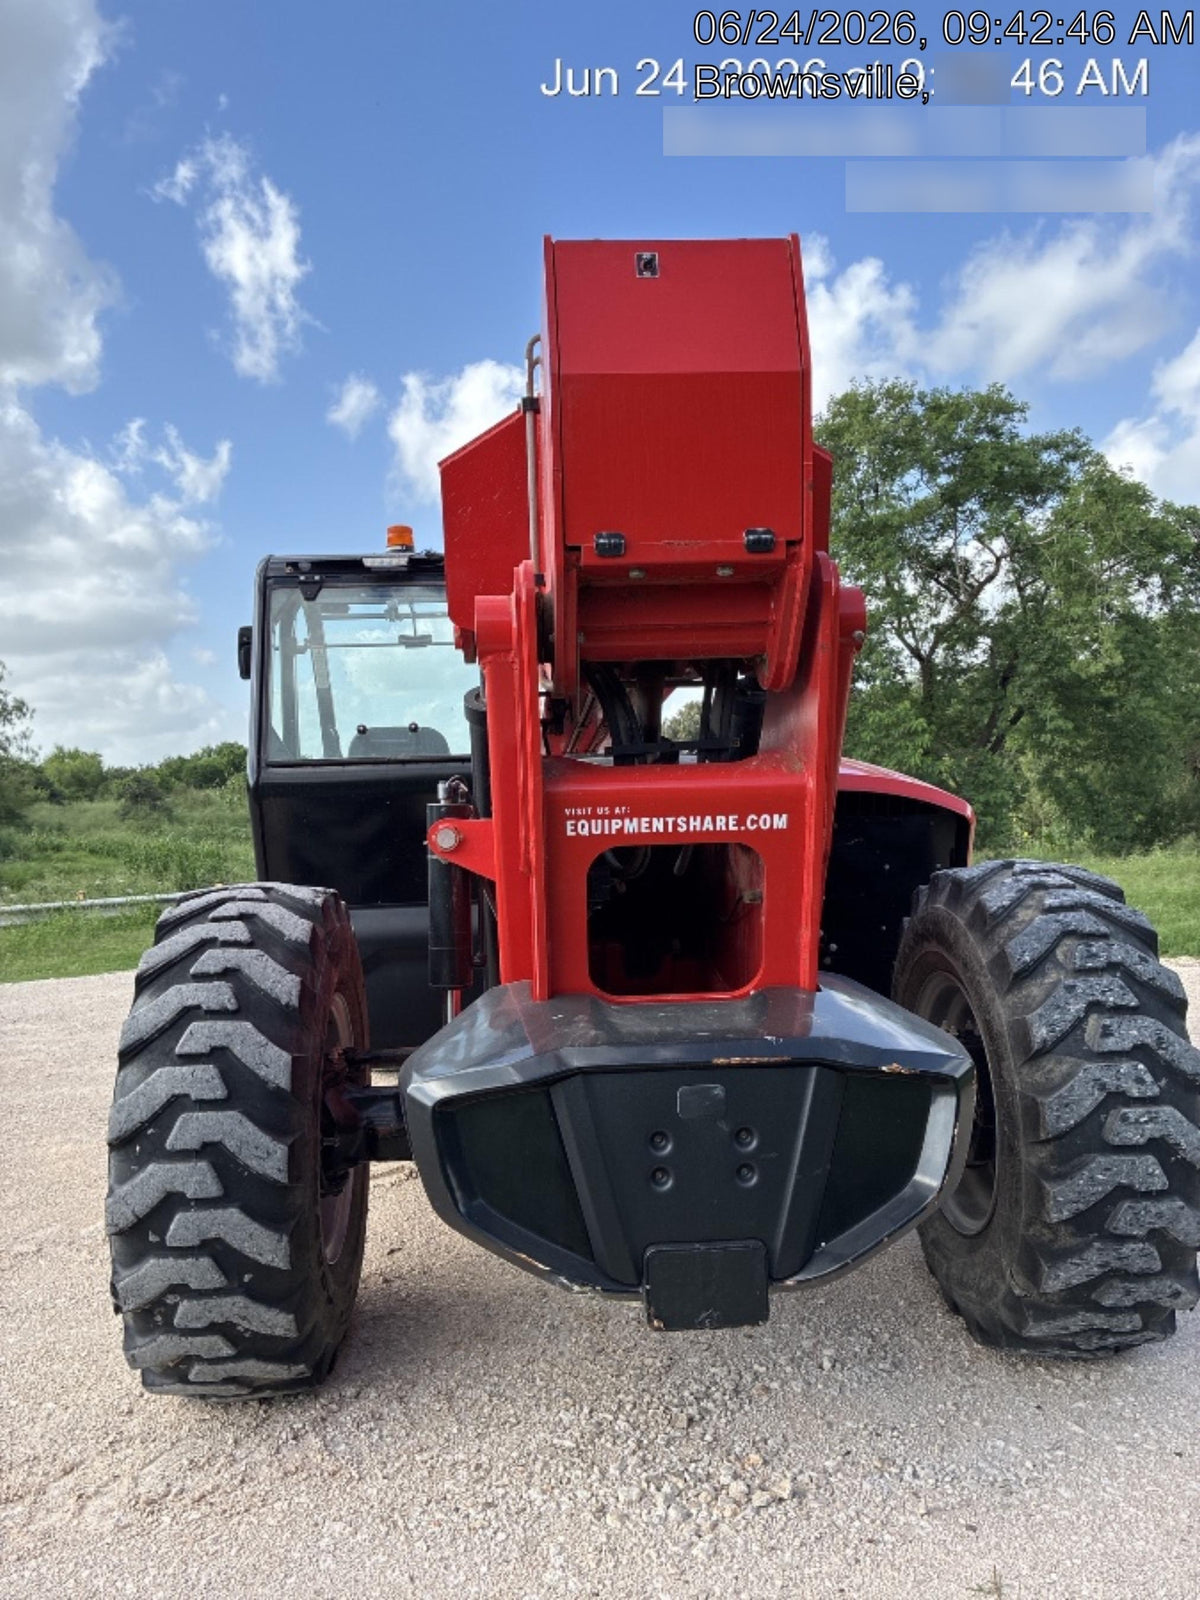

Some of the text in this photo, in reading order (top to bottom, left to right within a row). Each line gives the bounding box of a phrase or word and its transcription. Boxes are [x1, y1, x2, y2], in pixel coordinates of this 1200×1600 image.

[565, 806, 631, 816] VISIT US AT:
[566, 813, 788, 837] EQUIPMENTSHARE.COM
